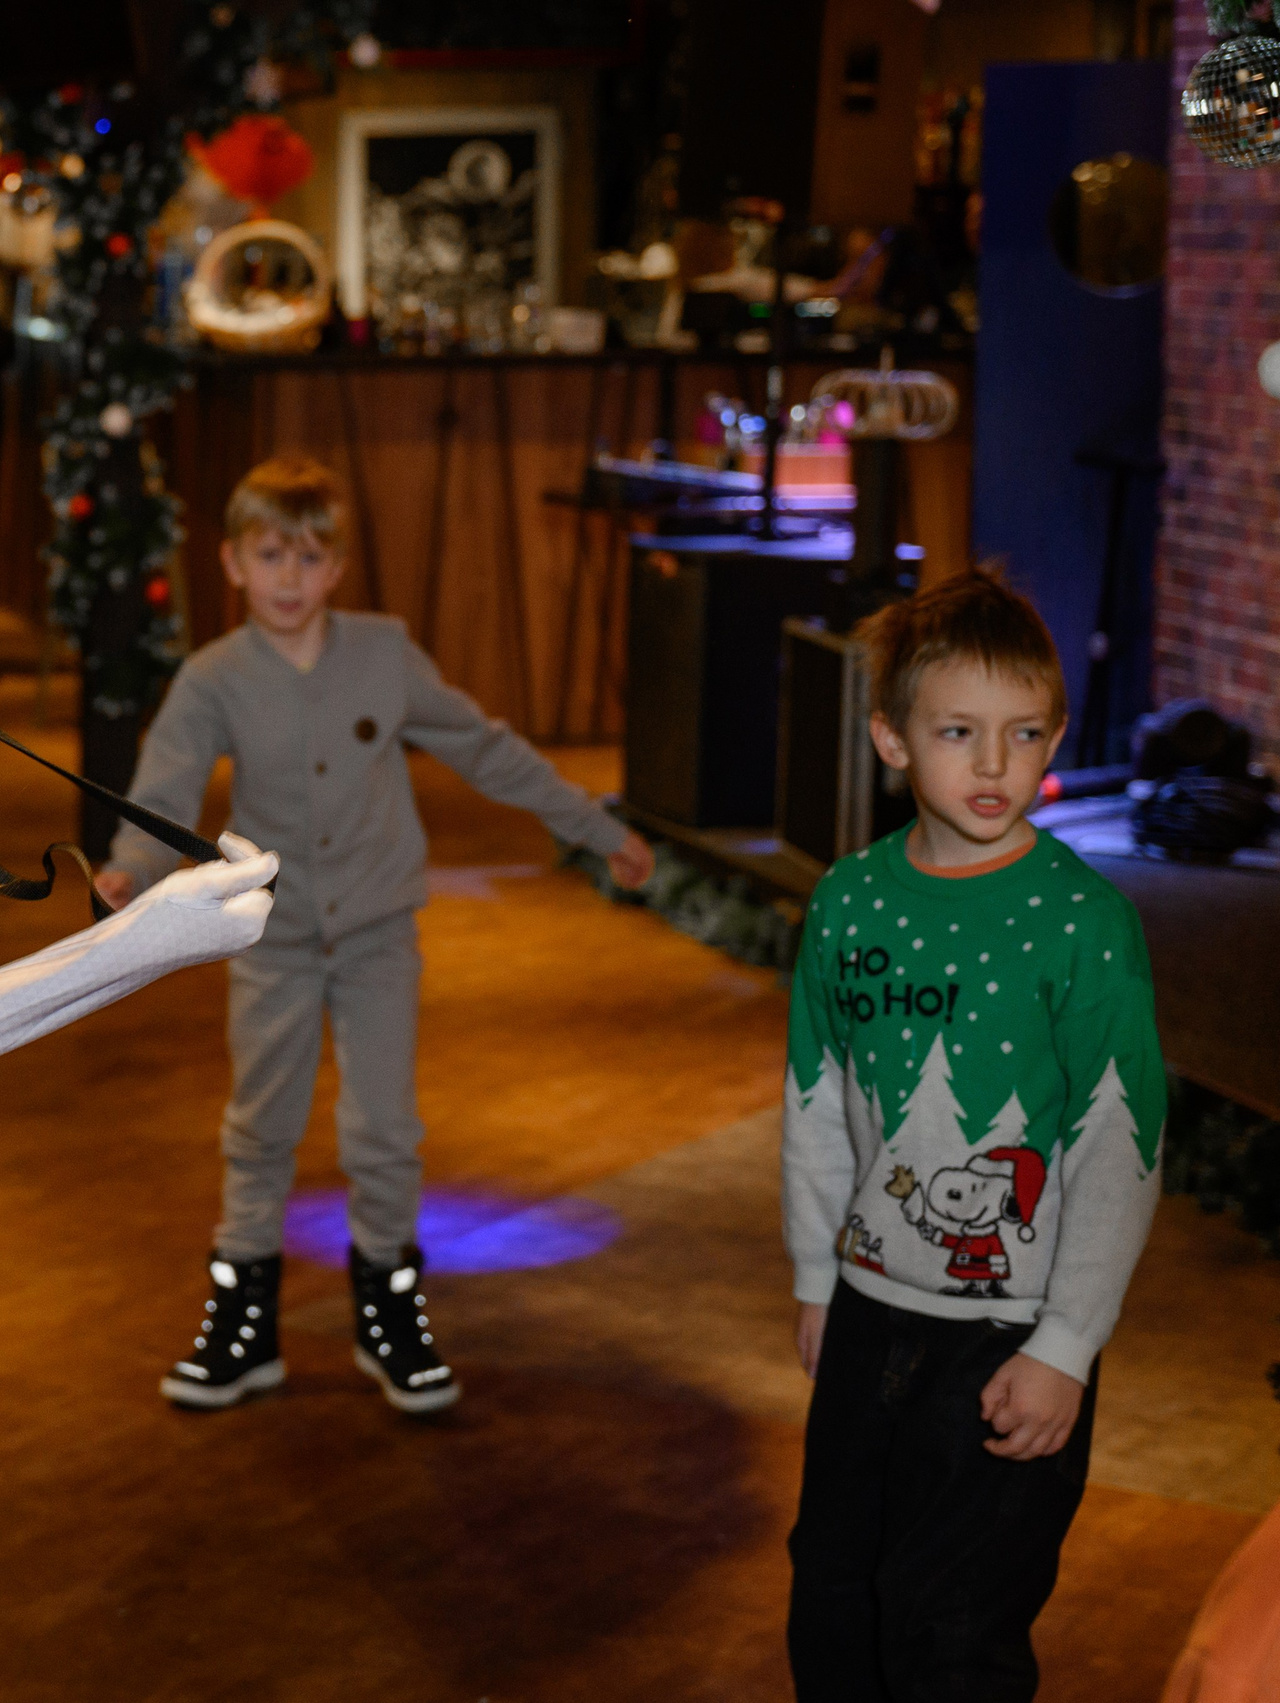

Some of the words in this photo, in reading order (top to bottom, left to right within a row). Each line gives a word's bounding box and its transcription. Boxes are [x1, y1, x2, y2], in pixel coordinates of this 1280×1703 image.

[838, 947, 889, 981] HO
[835, 986, 875, 1022] HO
[883, 982, 959, 1024] HO!
